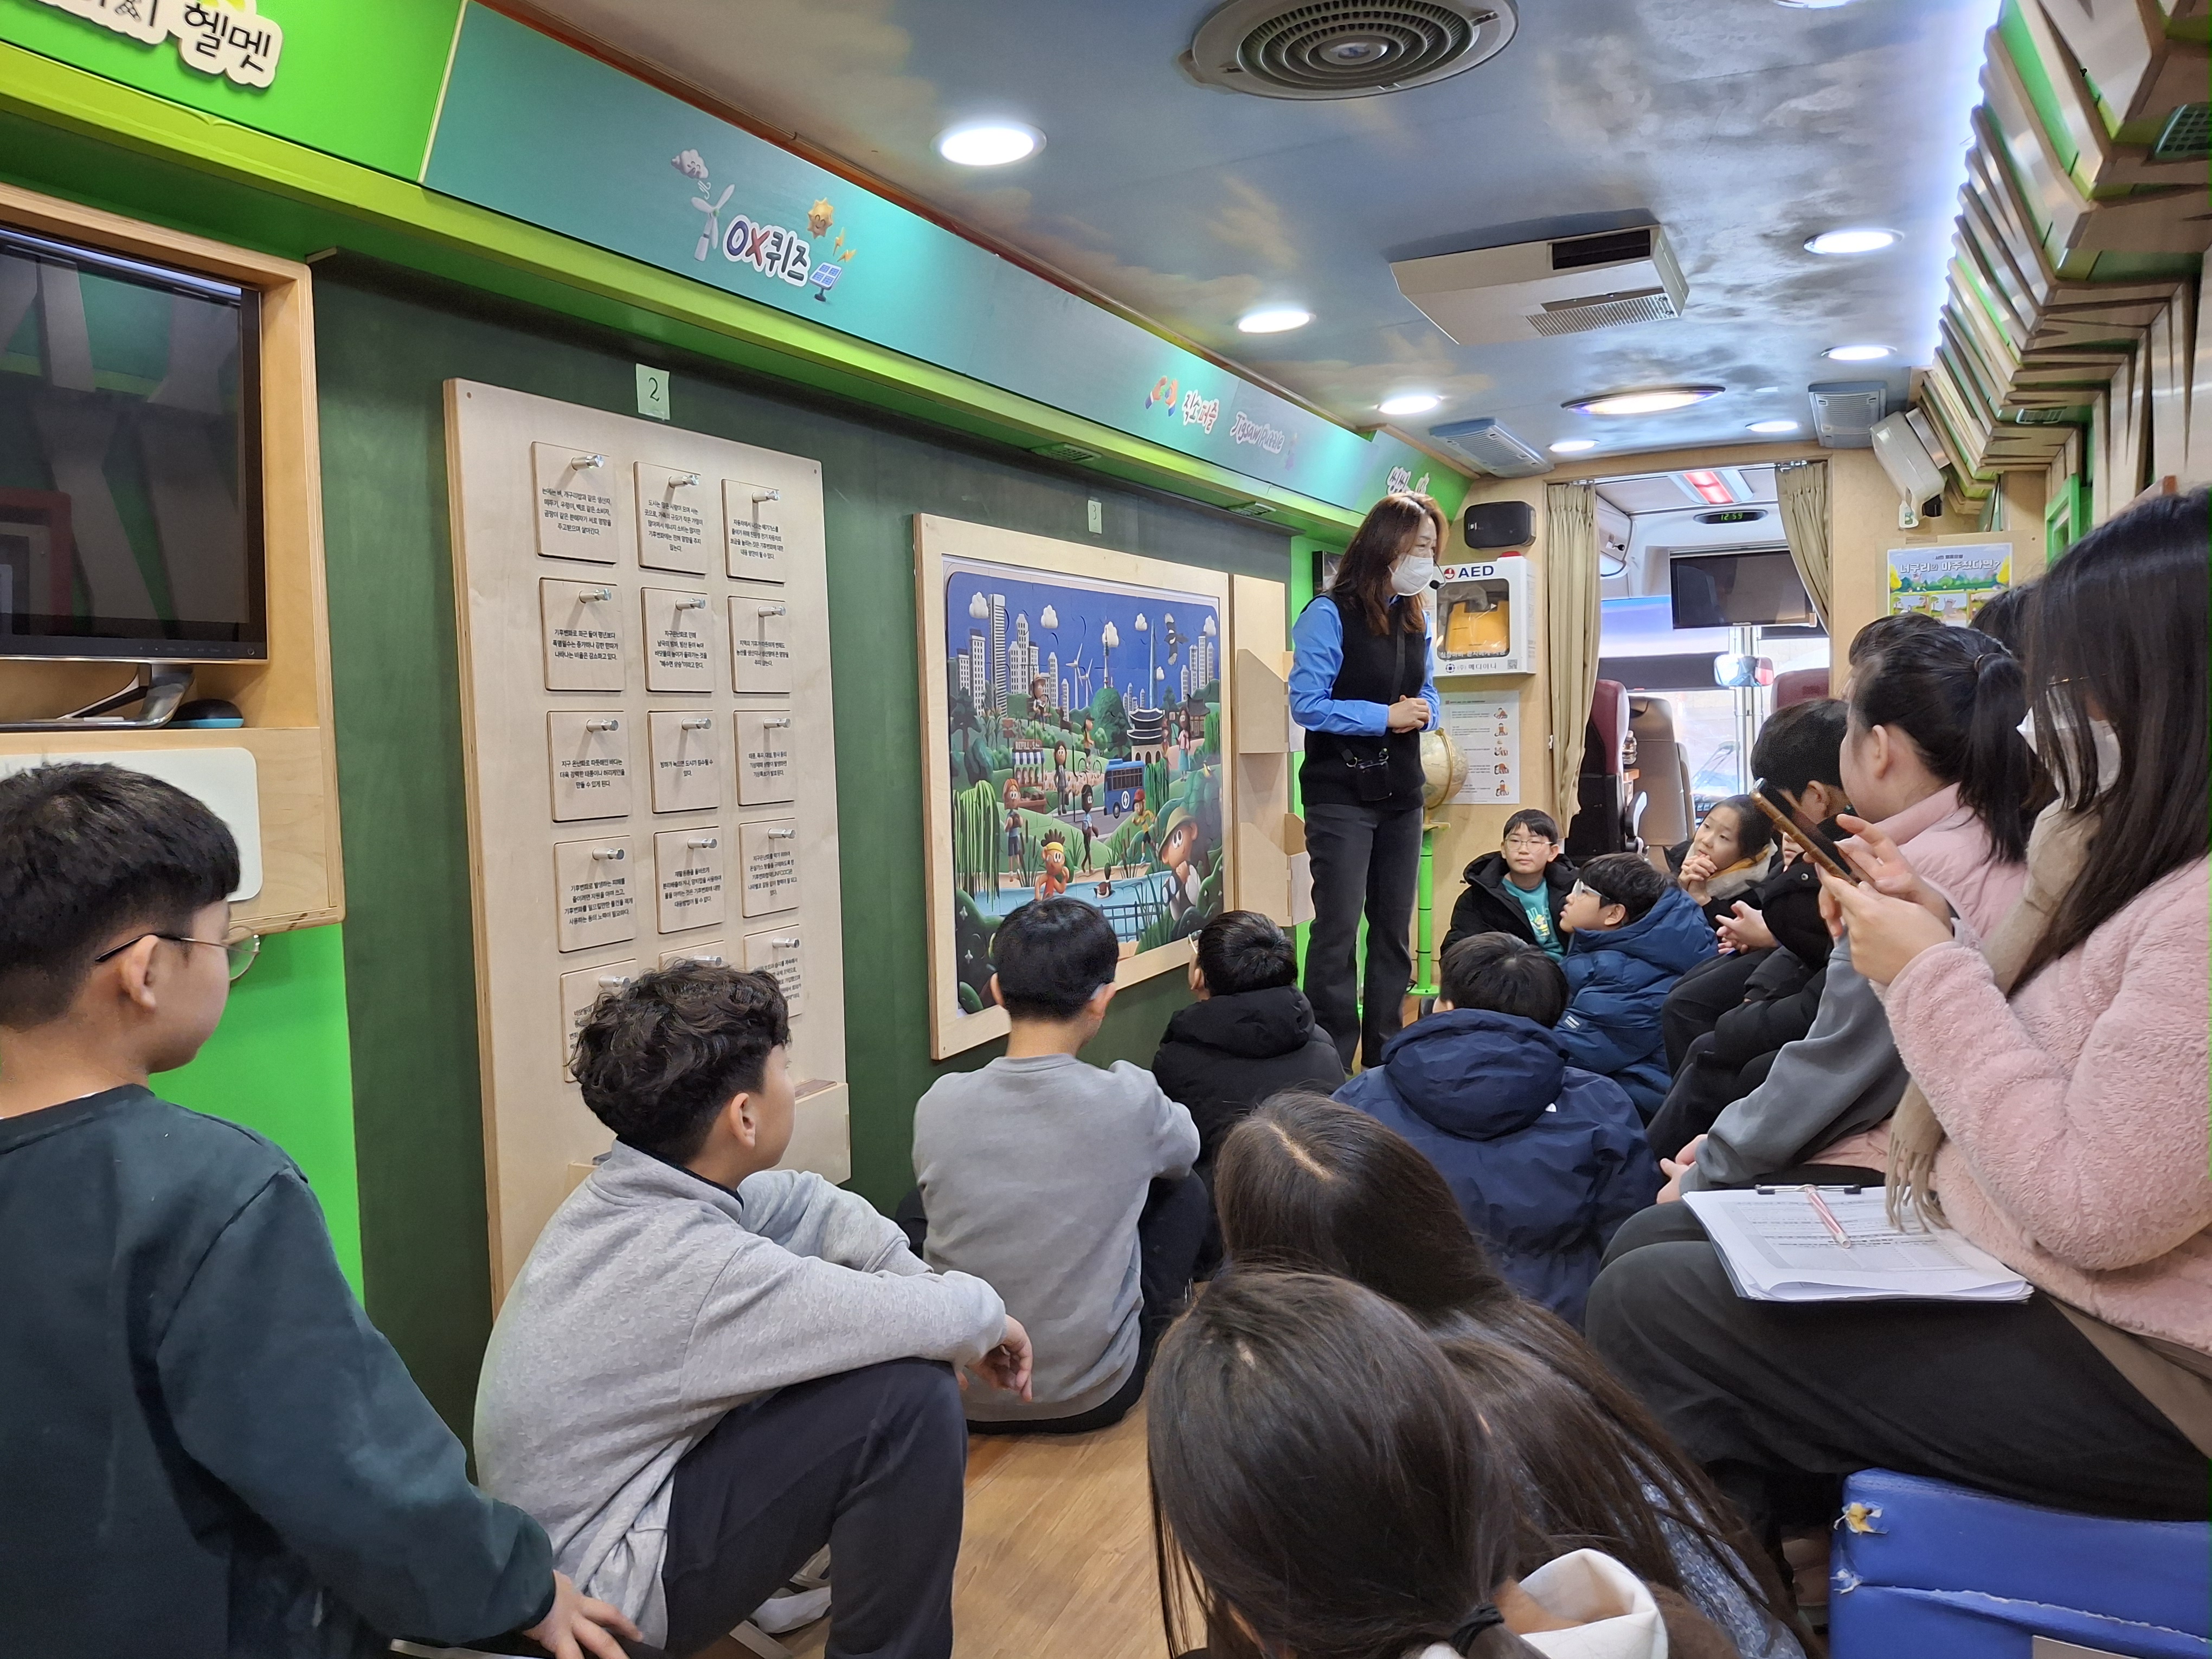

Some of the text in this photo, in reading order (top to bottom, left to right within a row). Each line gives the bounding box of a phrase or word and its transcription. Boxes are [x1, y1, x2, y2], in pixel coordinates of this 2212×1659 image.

[184, 3, 271, 73] 헬멧
[726, 220, 807, 281] OX퀴즈
[648, 377, 660, 402] 2
[1231, 414, 1261, 441] Jigsaw
[1092, 504, 1097, 520] 3
[1458, 565, 1495, 578] AED
[1900, 559, 2001, 574] 너구리와 마주쳤다면?
